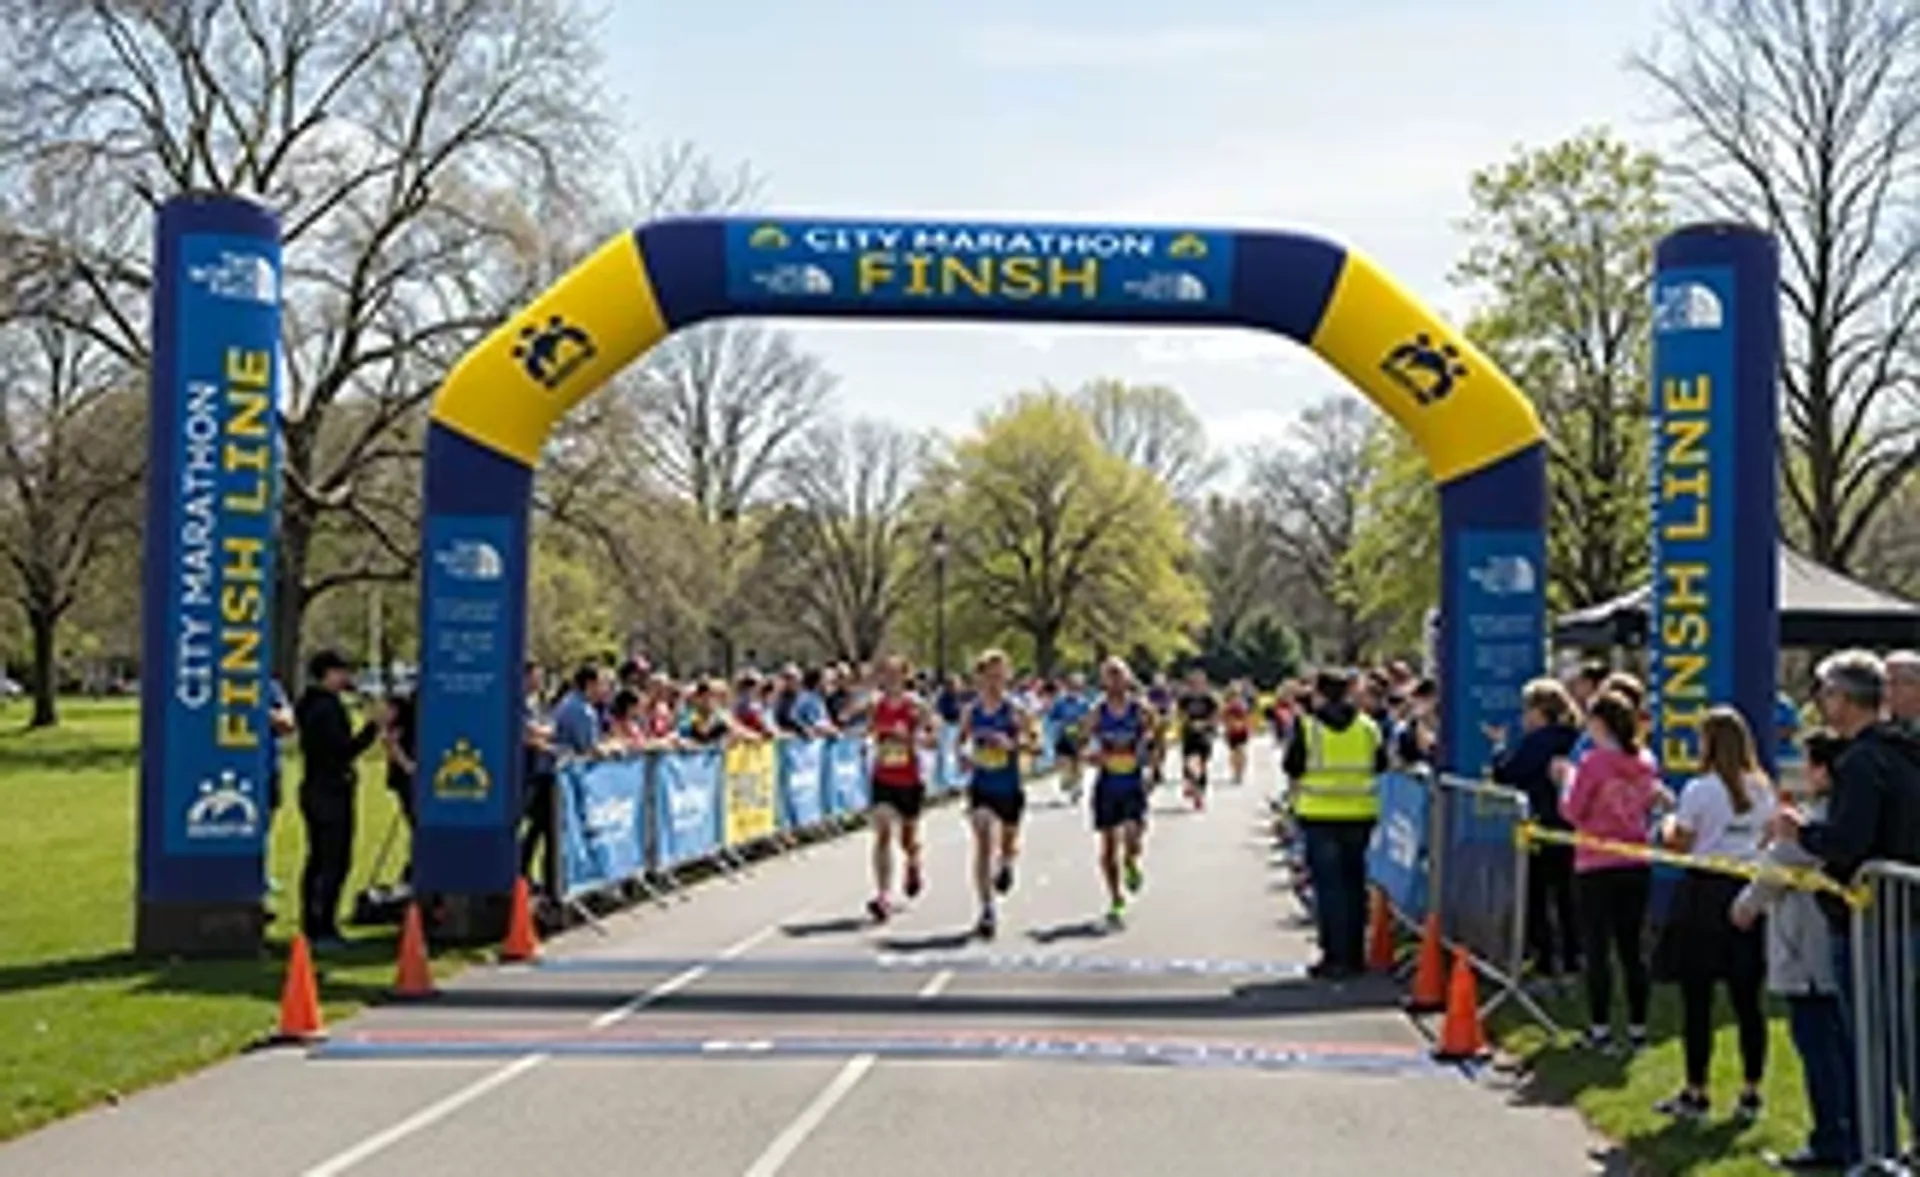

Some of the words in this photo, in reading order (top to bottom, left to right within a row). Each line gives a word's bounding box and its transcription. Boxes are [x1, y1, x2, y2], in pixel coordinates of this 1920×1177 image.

[804, 228, 902, 252] CITY
[912, 229, 1155, 257] MARATHON
[858, 252, 1099, 300] FINSH
[181, 380, 218, 605] MARATHON
[224, 346, 271, 512] LINE
[1663, 375, 1711, 540] LINE
[176, 614, 213, 711] CITY
[217, 536, 265, 747] FINSH
[1663, 563, 1711, 772] FINSH
